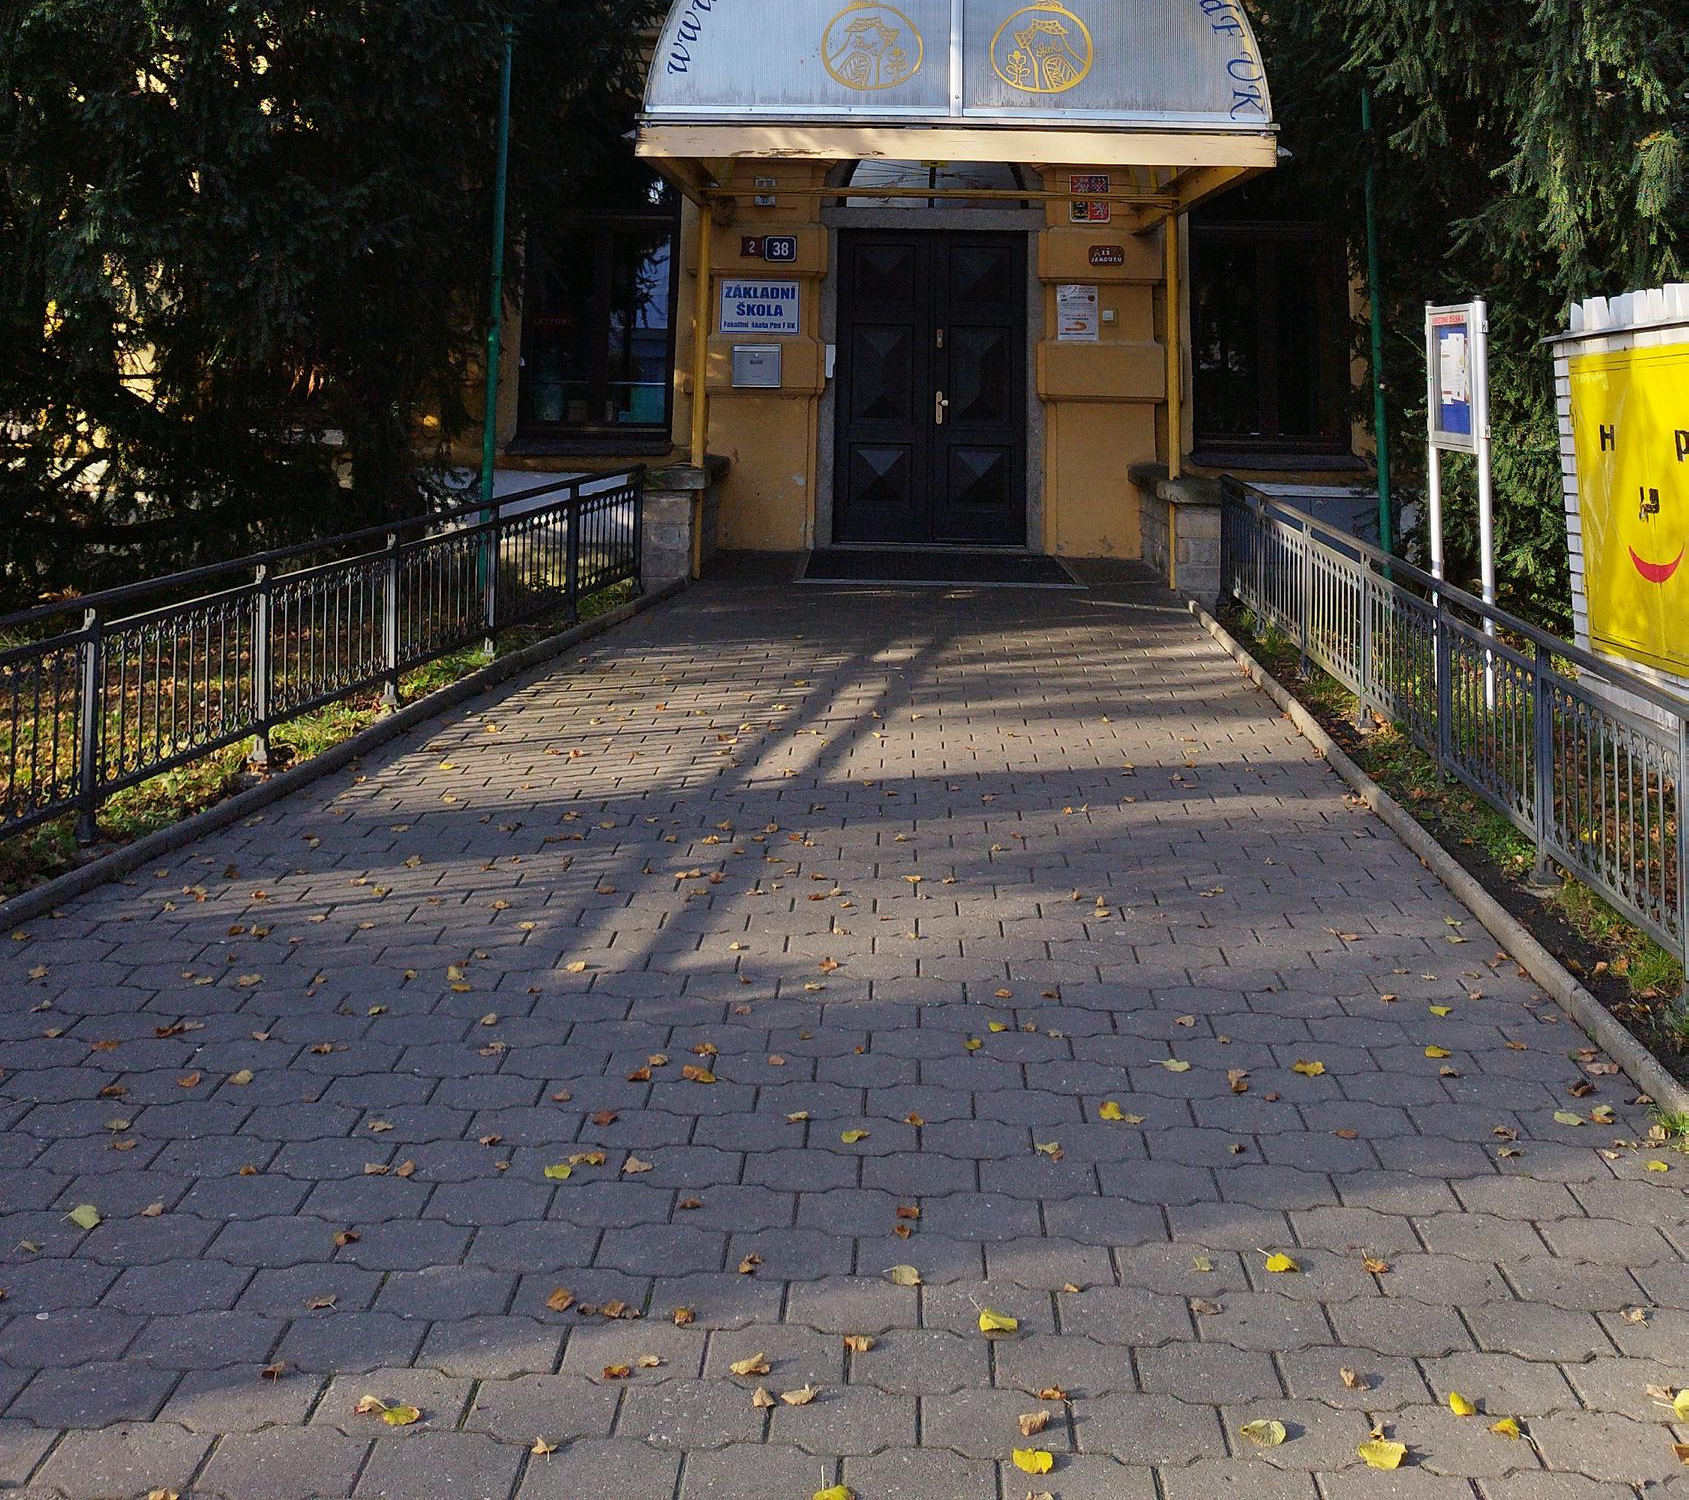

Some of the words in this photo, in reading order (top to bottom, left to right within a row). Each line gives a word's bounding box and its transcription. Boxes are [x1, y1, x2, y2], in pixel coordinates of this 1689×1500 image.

[1227, 51, 1264, 120] UK
[748, 241, 756, 253] 2
[772, 241, 789, 256] 38
[724, 284, 796, 300] ZÁKLADNÍ
[736, 301, 783, 317] ŠKOLA
